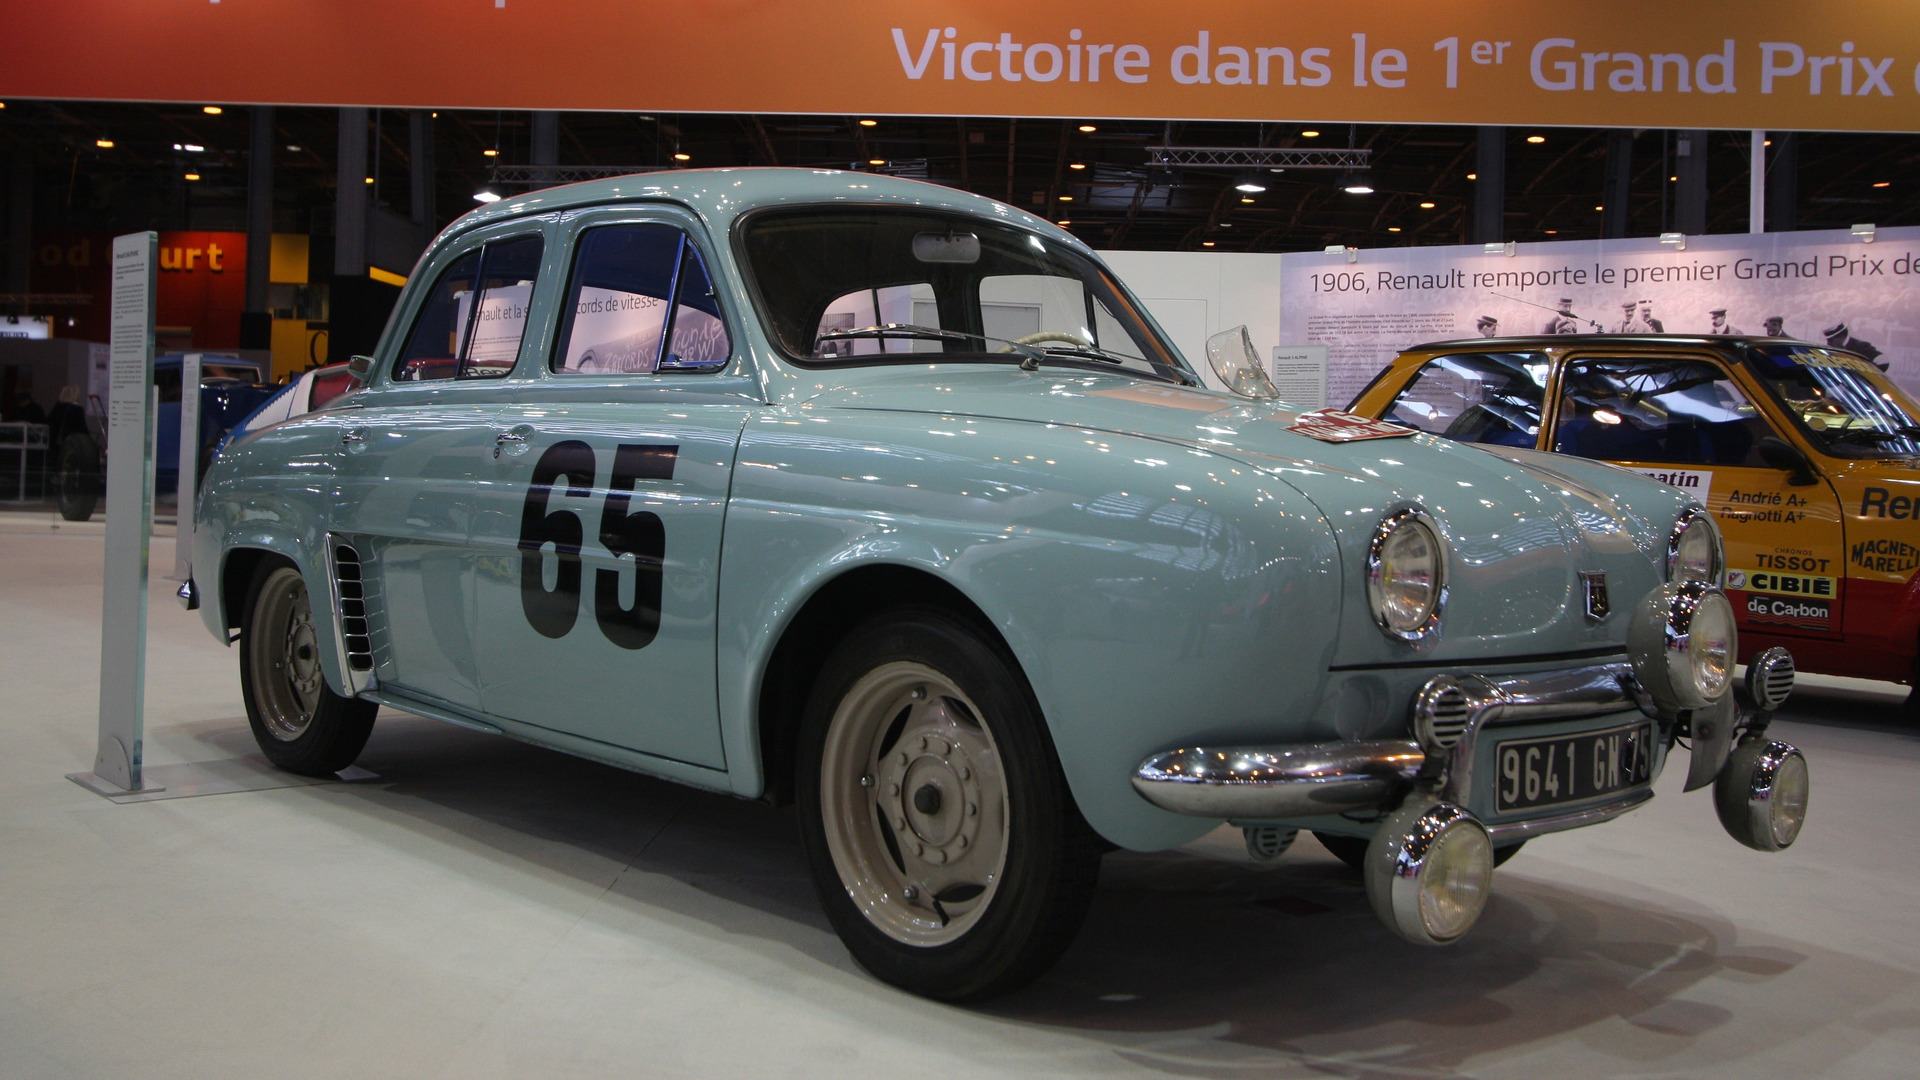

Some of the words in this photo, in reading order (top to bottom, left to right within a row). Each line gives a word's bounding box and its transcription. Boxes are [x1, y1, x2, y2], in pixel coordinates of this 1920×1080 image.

[891, 26, 1150, 83] Victoire
[1170, 30, 1331, 87] dans
[1352, 32, 1407, 88] le
[1530, 37, 1737, 94] Grand
[1759, 41, 1895, 96] Prix
[1310, 271, 1370, 294] 1906,
[1378, 268, 1466, 290] Renault
[1473, 266, 1587, 292] remporte
[1595, 263, 1615, 283] le
[1624, 260, 1727, 289] premier
[1735, 255, 1818, 280] Grand
[1829, 254, 1884, 277] Prix
[503, 306, 513, 320] et
[514, 303, 522, 319] la
[576, 298, 603, 315] cords
[605, 296, 618, 312] de
[621, 294, 660, 310] vitesse
[1645, 471, 1699, 488] atin
[1729, 490, 1782, 505] Andrié
[1786, 493, 1807, 507] A+
[1784, 511, 1806, 523] A+
[517, 439, 680, 650] 65
[1756, 553, 1830, 573] TISSOT
[1748, 599, 1767, 614] de
[1771, 601, 1829, 618] Carbon
[1502, 741, 1576, 804] 9641
[1593, 735, 1619, 791] GN
